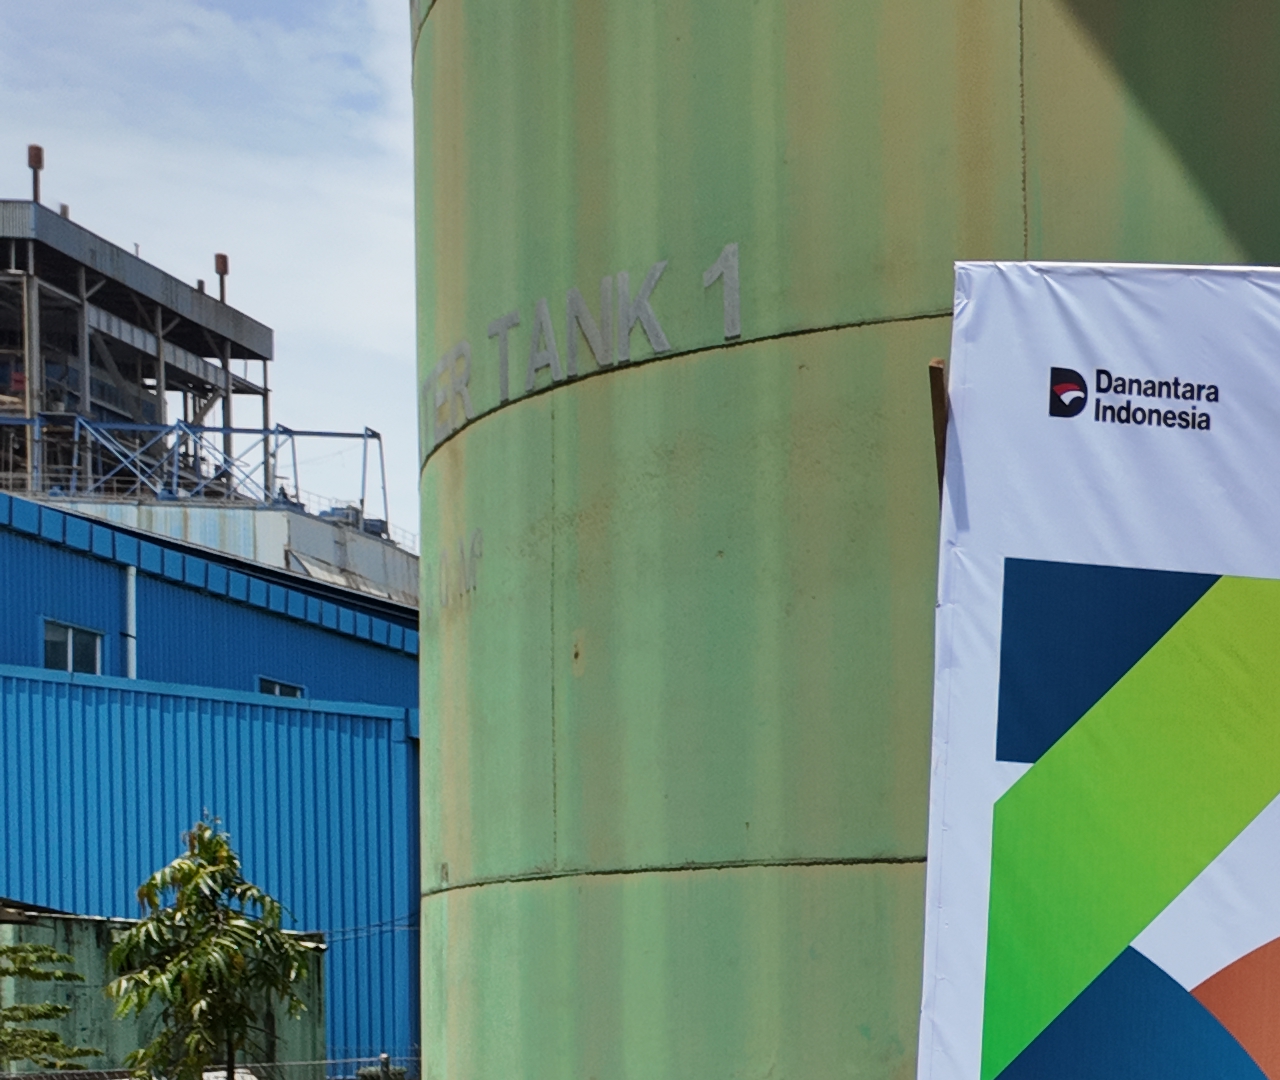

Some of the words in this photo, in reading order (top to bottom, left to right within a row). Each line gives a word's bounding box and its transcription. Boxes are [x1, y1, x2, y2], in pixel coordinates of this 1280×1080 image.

[487, 258, 671, 402] TANK
[702, 242, 740, 341] 1
[1095, 368, 1219, 402] Danantara
[1094, 398, 1211, 430] Indonesia
